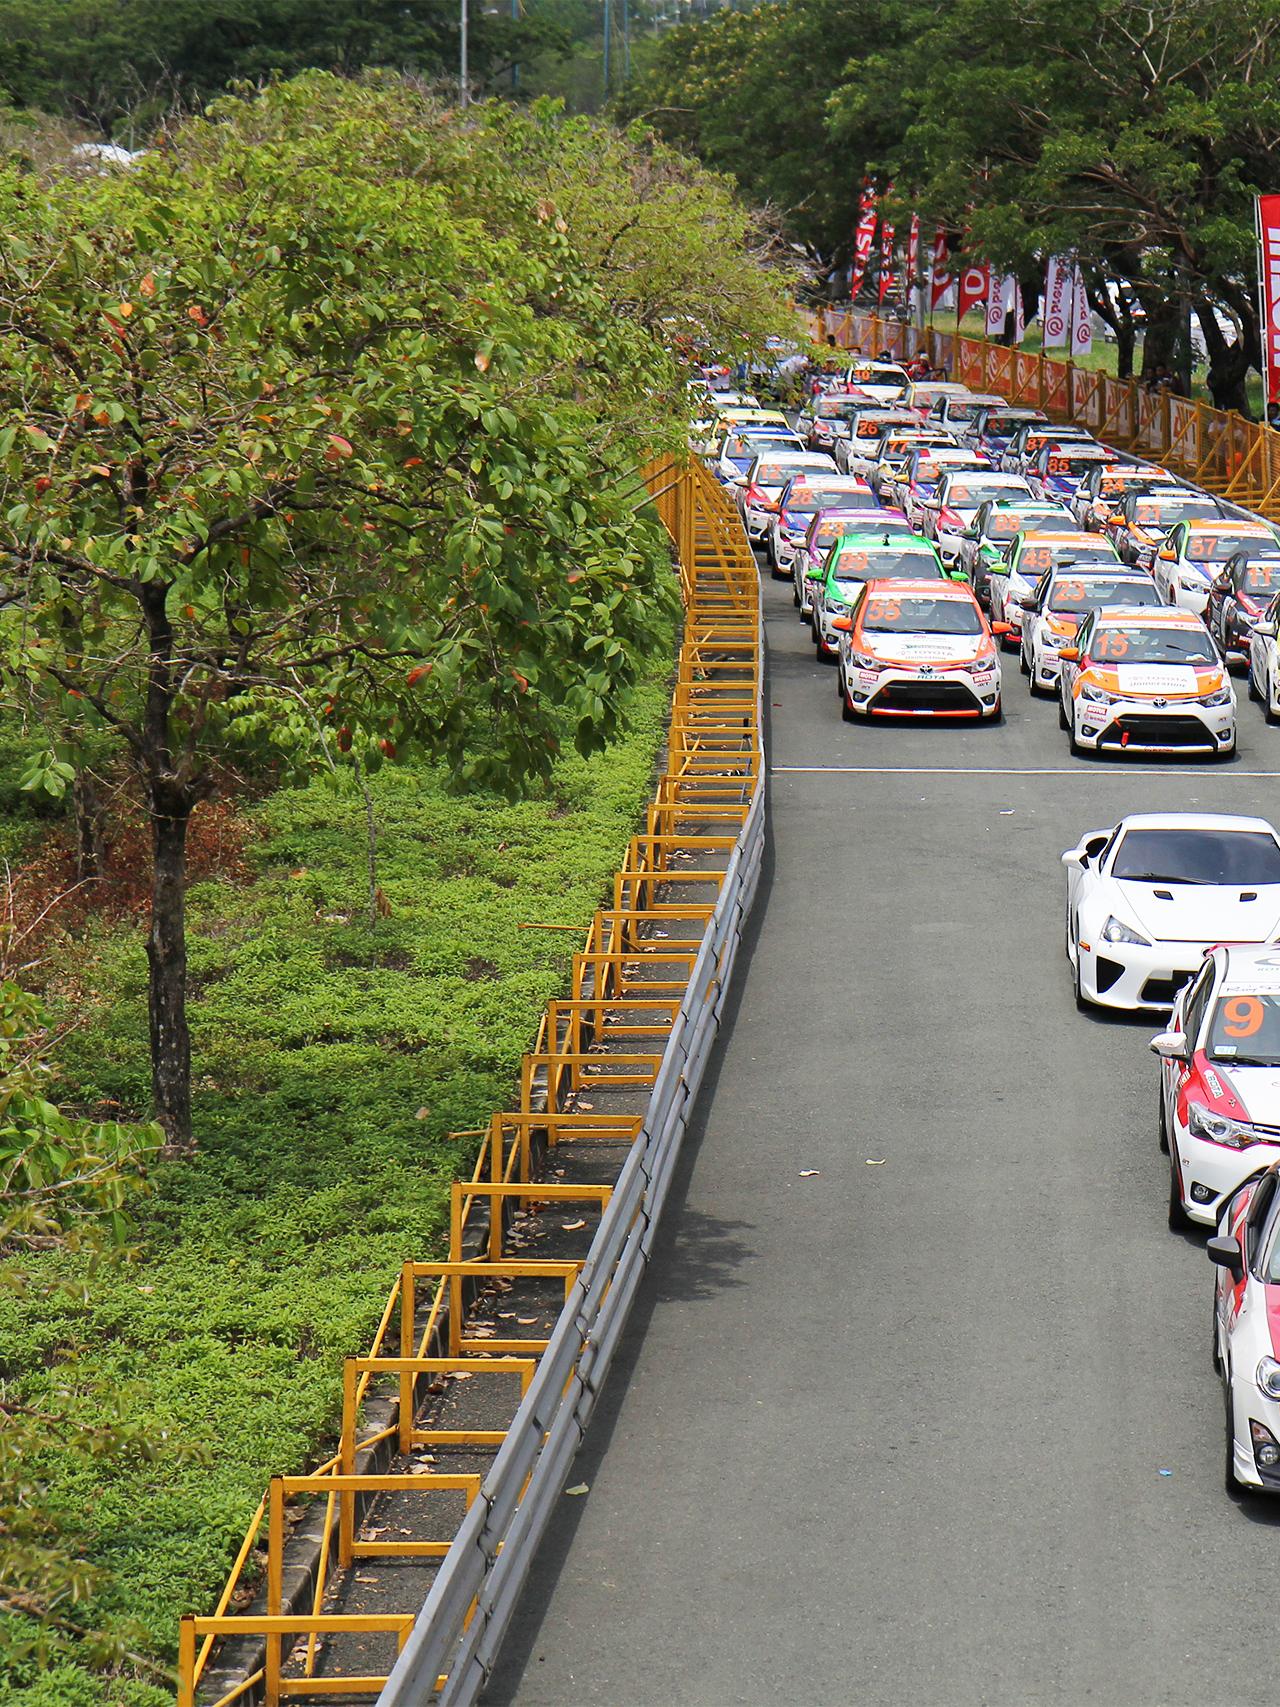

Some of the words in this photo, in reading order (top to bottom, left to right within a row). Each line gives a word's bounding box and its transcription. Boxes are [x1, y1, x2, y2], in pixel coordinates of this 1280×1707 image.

[858, 421, 878, 435] 26
[890, 441, 909, 453] 77
[1026, 437, 1048, 450] 87
[761, 464, 782, 480] 12
[1102, 478, 1125, 493] 24
[1190, 538, 1218, 556] 57
[1022, 548, 1052, 568] 45
[1054, 581, 1085, 601] 23
[867, 599, 902, 621] 55
[1096, 633, 1129, 657] 15
[1223, 997, 1264, 1038] 9
